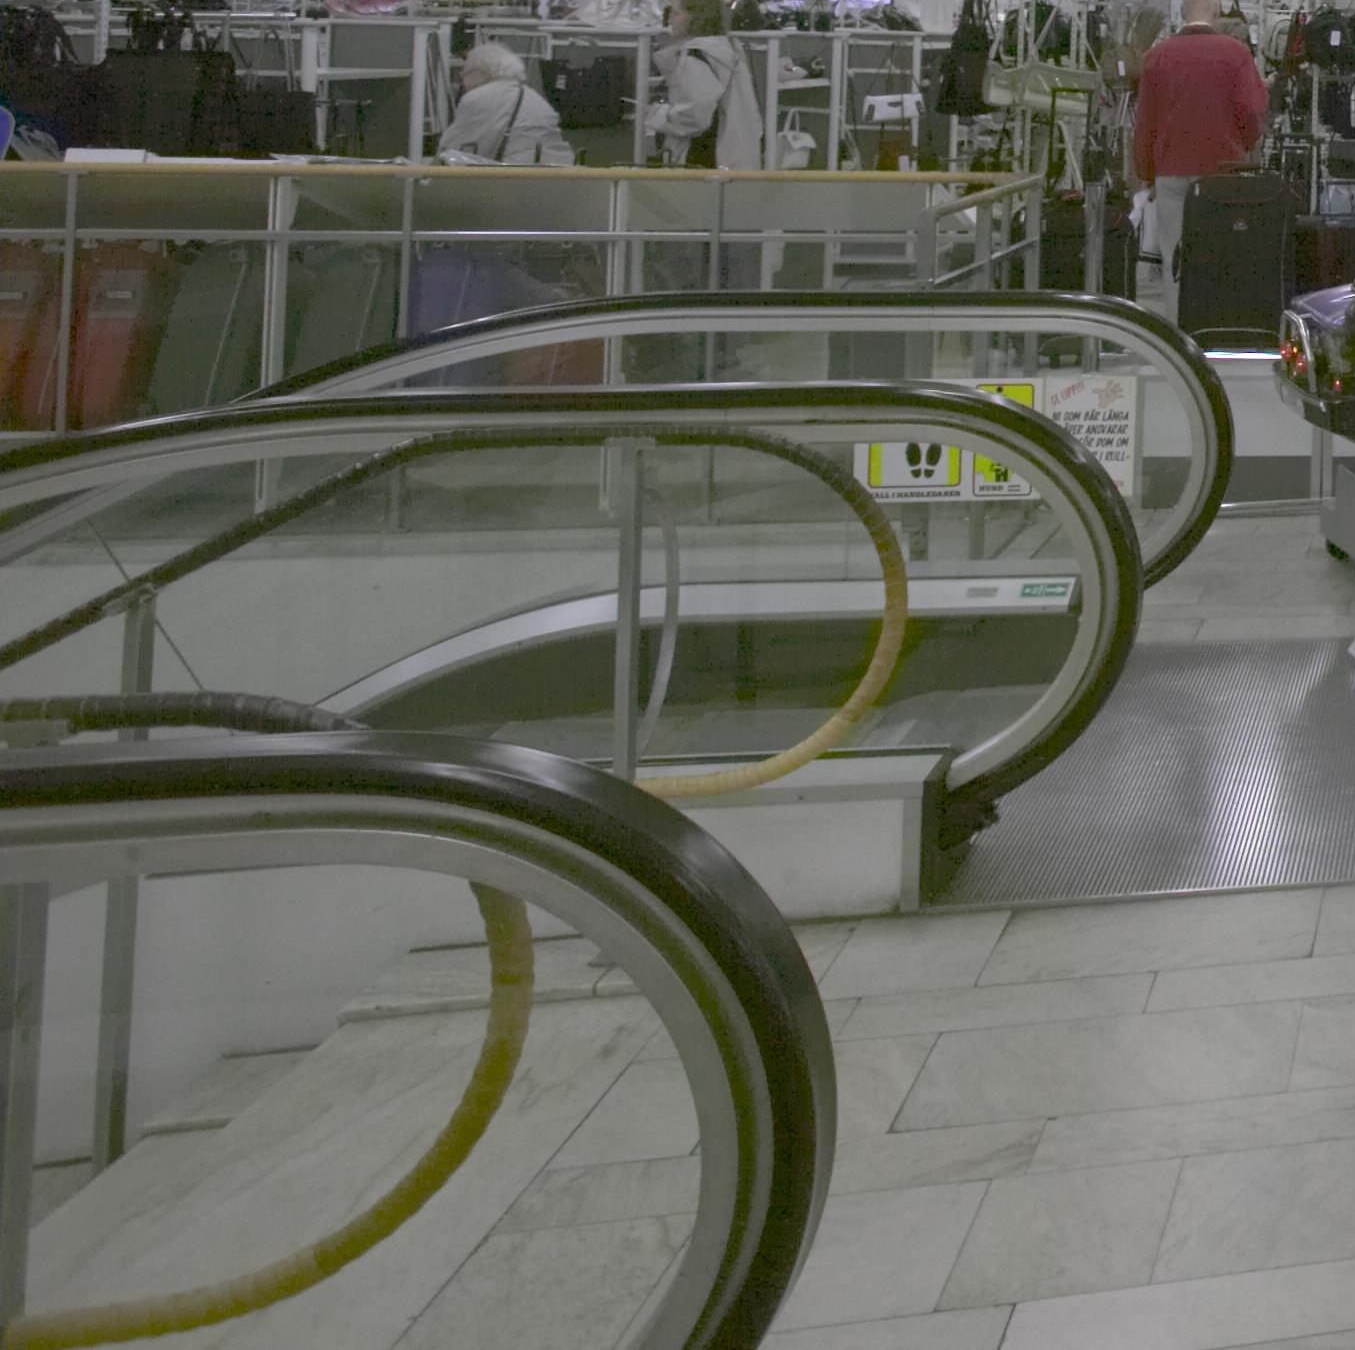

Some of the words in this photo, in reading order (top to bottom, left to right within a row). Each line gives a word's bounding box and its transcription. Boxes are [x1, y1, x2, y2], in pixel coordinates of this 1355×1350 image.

[1063, 411, 1082, 421] SOM
[1084, 409, 1101, 421] BÄR
[1102, 409, 1129, 421] LÅNGA
[1115, 437, 1130, 448] OM
